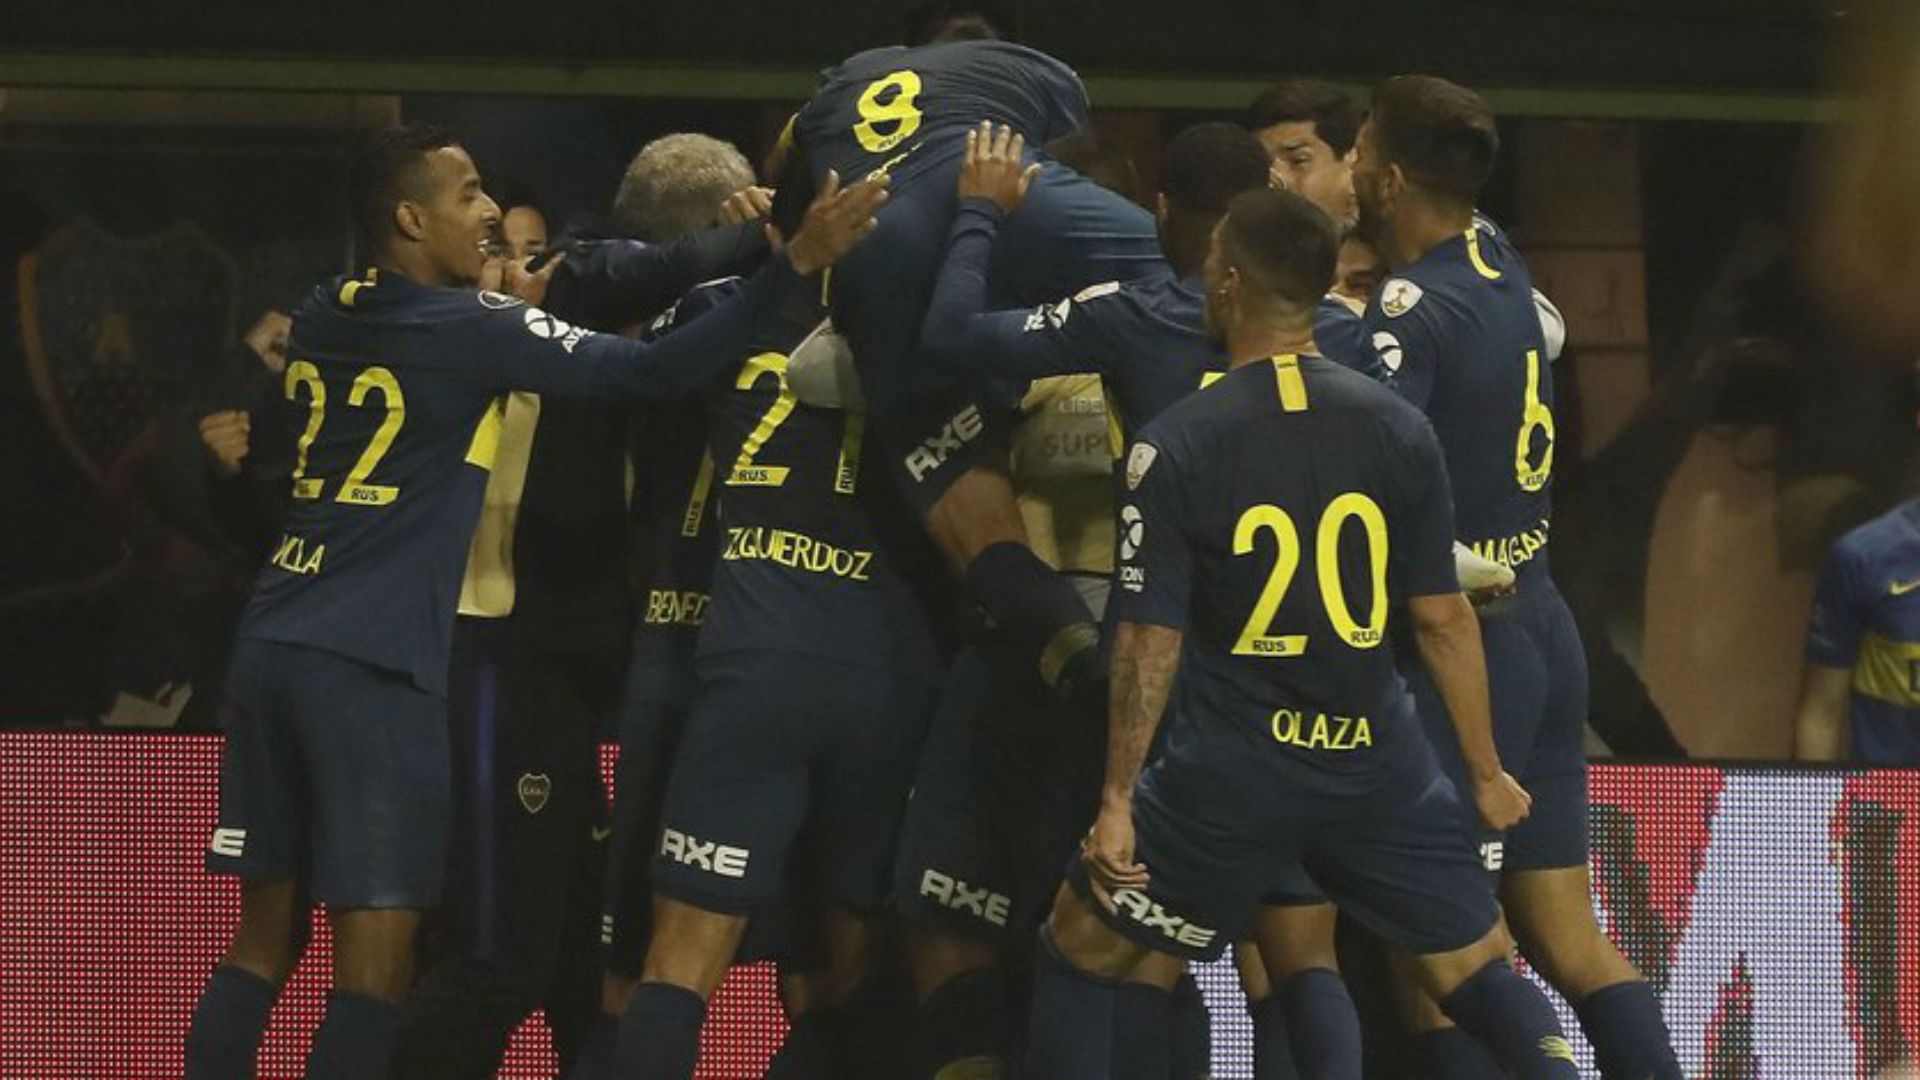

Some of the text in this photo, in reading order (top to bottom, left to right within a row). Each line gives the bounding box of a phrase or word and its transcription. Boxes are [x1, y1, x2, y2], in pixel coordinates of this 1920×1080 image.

[853, 70, 923, 153] 8
[284, 361, 405, 505] 22
[905, 404, 985, 483] AXE
[1515, 349, 1555, 491] 6
[1229, 491, 1390, 658] 20
[1252, 639, 1287, 652] RUS
[1271, 707, 1374, 750] OLAZA
[660, 828, 750, 879] AXE
[919, 868, 1012, 928] AXE
[1110, 888, 1217, 948] AXE
